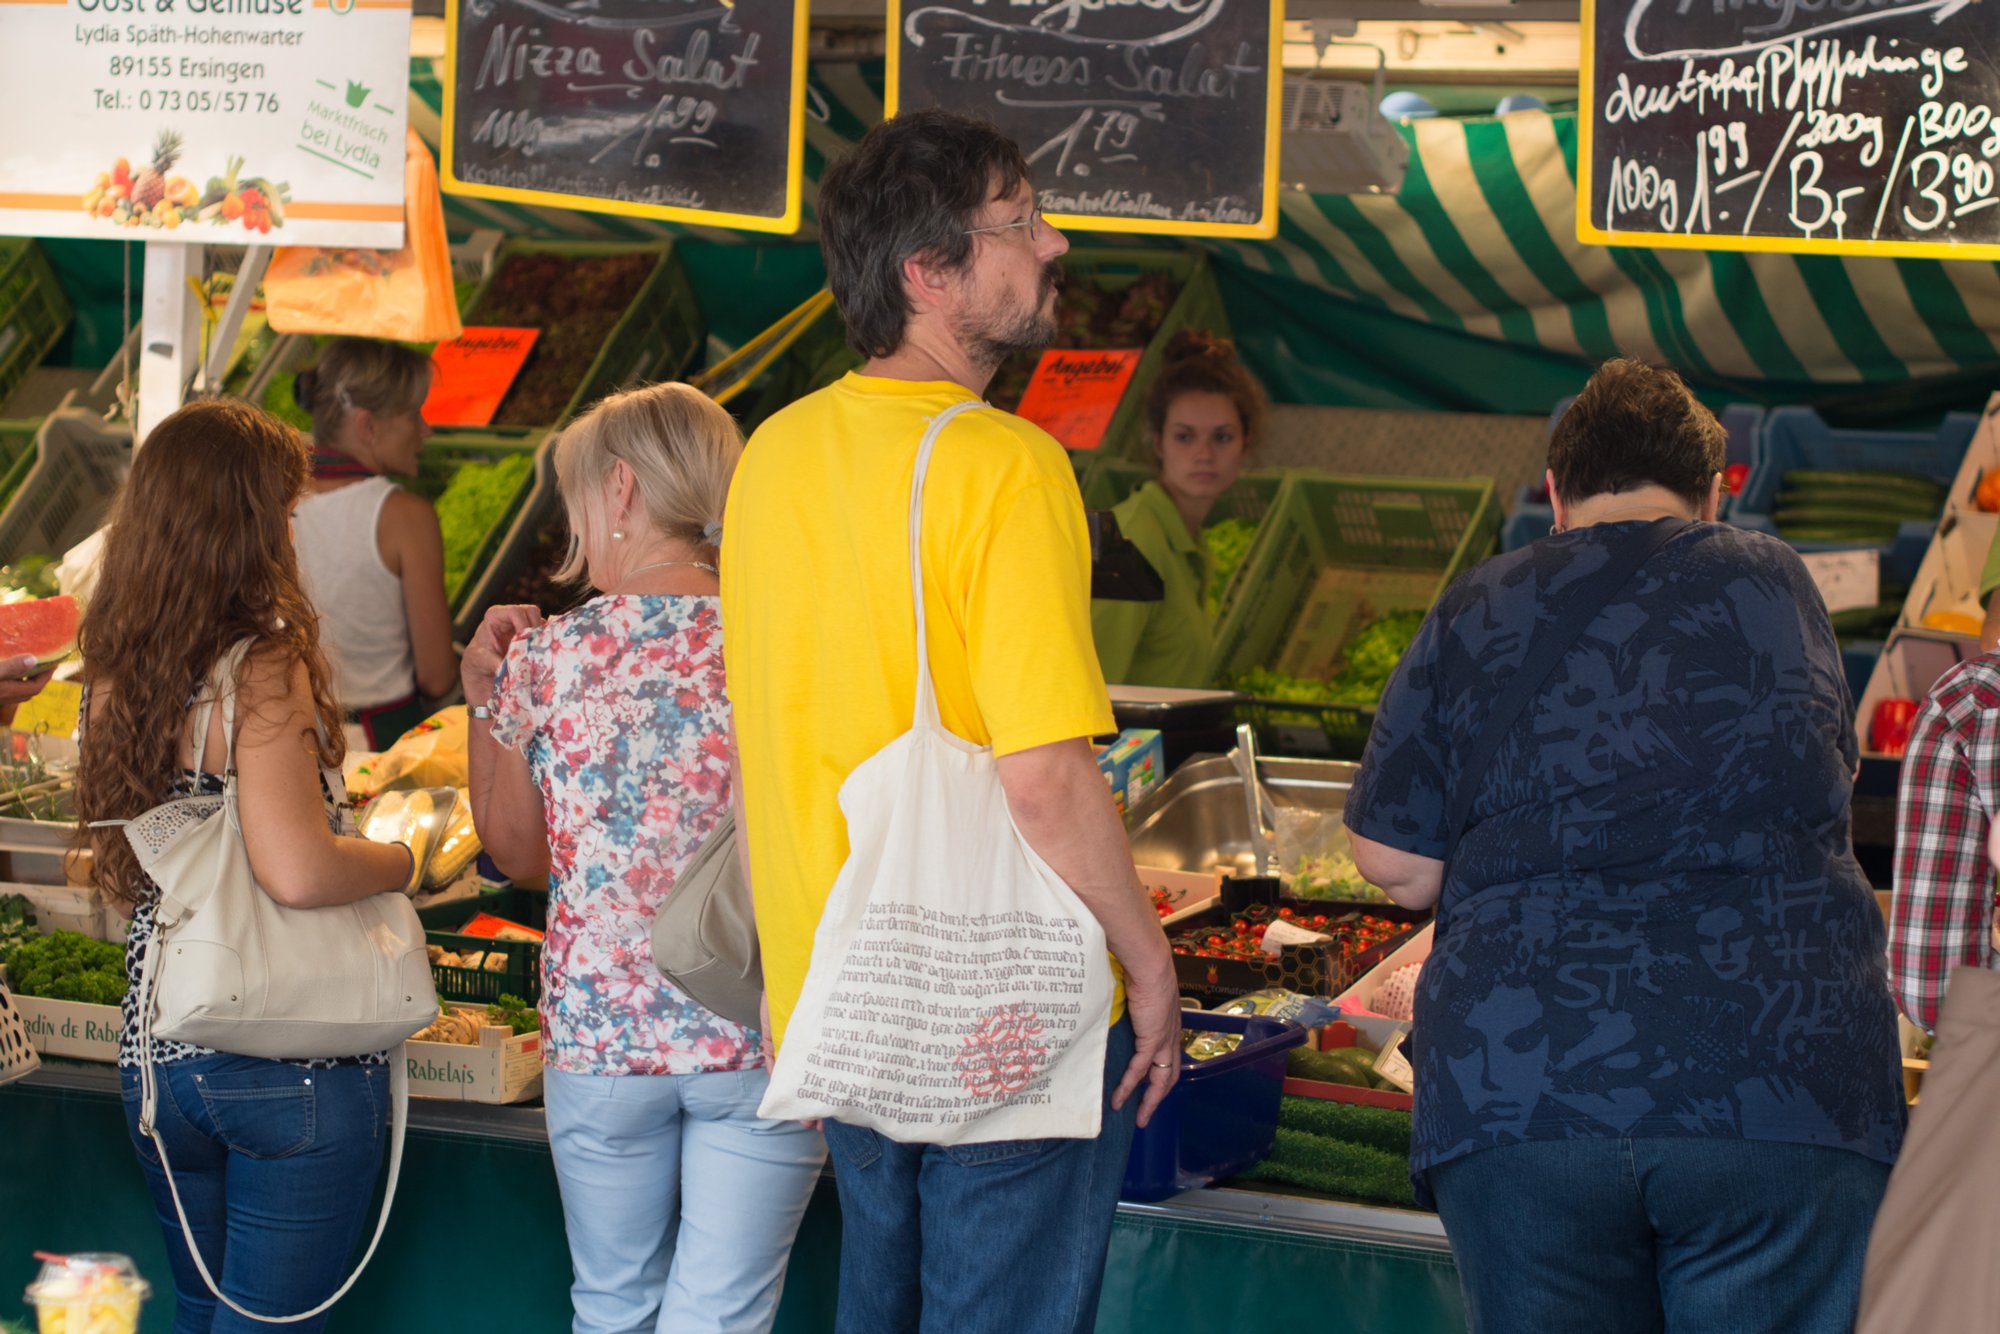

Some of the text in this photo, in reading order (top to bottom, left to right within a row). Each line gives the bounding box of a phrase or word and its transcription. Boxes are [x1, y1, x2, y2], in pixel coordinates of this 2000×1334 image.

[75, 24, 304, 46] Lydia Späth-Hohenwarter
[109, 56, 265, 83] 89155 Ersingen
[475, 24, 761, 91] Nizza Salat
[942, 32, 1261, 99] Fitness Salat
[94, 89, 132, 110] Tel.:
[301, 119, 380, 168] bei Lydia
[307, 100, 388, 144] Marktfrisch
[1606, 156, 1678, 233] 100g
[406, 1058, 475, 1083] Rabelais
